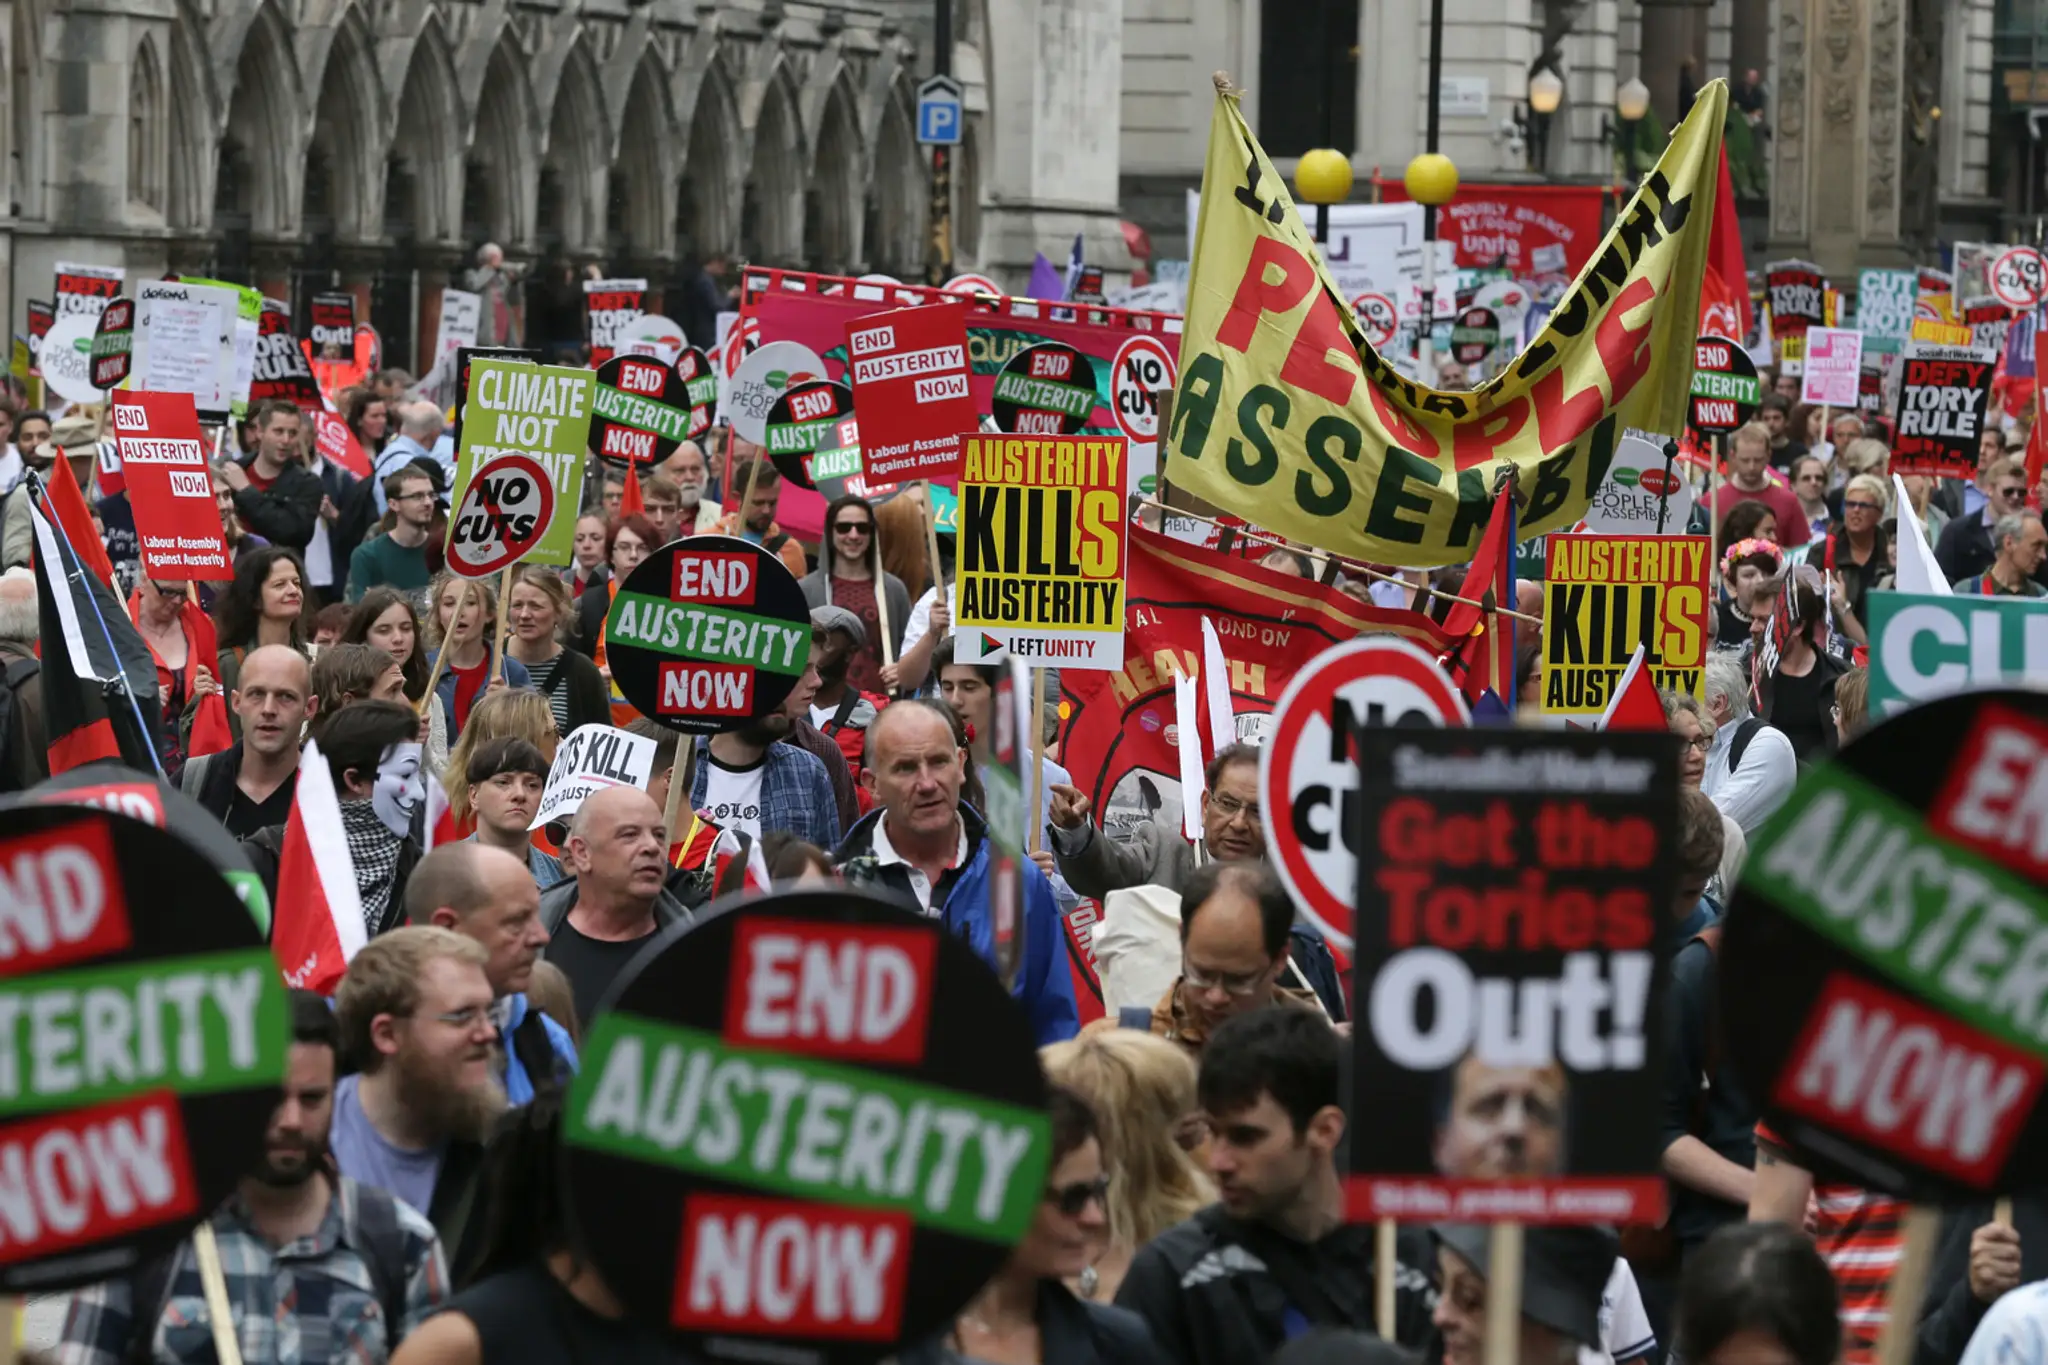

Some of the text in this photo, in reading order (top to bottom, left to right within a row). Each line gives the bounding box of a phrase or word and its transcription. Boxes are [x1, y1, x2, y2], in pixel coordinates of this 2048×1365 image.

[929, 105, 951, 136] P
[1462, 234, 1519, 256] unite
[2009, 256, 2040, 274] NO
[58, 275, 119, 296] DEFY
[142, 287, 188, 300] defend
[1771, 285, 1822, 302] TORY
[1861, 271, 1915, 292] CUT
[1357, 303, 1384, 316] NO
[1773, 298, 1822, 317] RULE
[255, 333, 299, 358] ORY
[311, 325, 353, 346] Out!
[855, 330, 891, 351] END
[46, 353, 90, 370] PEOPL
[859, 349, 960, 380] AUSTERITY
[1032, 353, 1070, 376] END
[1697, 346, 1728, 367] END
[622, 365, 662, 392] END
[1126, 357, 1162, 384] NO
[1907, 360, 1987, 387] DEFY
[477, 369, 587, 419] CLIMATE
[743, 381, 766, 392] THE
[920, 378, 964, 399] NOW
[998, 376, 1093, 415] AUSTERITY
[1691, 371, 1757, 401] STERITY
[1904, 386, 1984, 412] TORY
[731, 392, 778, 408] PEOP
[745, 408, 766, 419] ASS
[791, 391, 831, 420] END
[1118, 389, 1158, 416] CUT
[1697, 402, 1736, 423] NOW
[117, 408, 144, 427] END
[495, 413, 560, 448] NOT
[1016, 412, 1062, 434] NOW
[1899, 410, 1978, 439] RULE
[605, 429, 654, 457] NOW
[771, 422, 834, 451] AUSTE
[868, 434, 959, 459] Labour Assemb
[124, 442, 200, 461] AUSTERITY
[818, 450, 860, 478] AUST
[871, 451, 959, 475] Against Auster
[964, 439, 1122, 487] AUSTERITY
[173, 476, 207, 493] NOW
[474, 477, 530, 507] NO
[1597, 481, 1618, 494] HE
[453, 513, 537, 544] CUTS
[1601, 508, 1672, 524] ASSEMBY
[143, 535, 175, 548] Labour
[177, 536, 221, 552] Assembly
[963, 485, 1120, 578] KILLS
[148, 552, 225, 568] Against Austerity
[1551, 539, 1706, 582] AUSTERITY
[679, 557, 750, 598] END
[961, 576, 1118, 625] AUSTERITY
[614, 599, 803, 668] AUSTERITY
[1549, 584, 1702, 666] KILLS
[1009, 637, 1096, 658] LEFTUNITY
[663, 668, 748, 711] NOW
[1378, 797, 1518, 869] Get
[1533, 798, 1656, 870] the
[0, 844, 105, 956] ND
[1376, 867, 1655, 952] Tories
[1761, 787, 2048, 1046] AUSTER
[743, 933, 918, 1043] END
[1369, 948, 1655, 1071] Out!
[1799, 999, 2026, 1165] NOW
[584, 1034, 1033, 1223] AUSTERITY
[688, 1212, 897, 1323] NOW
